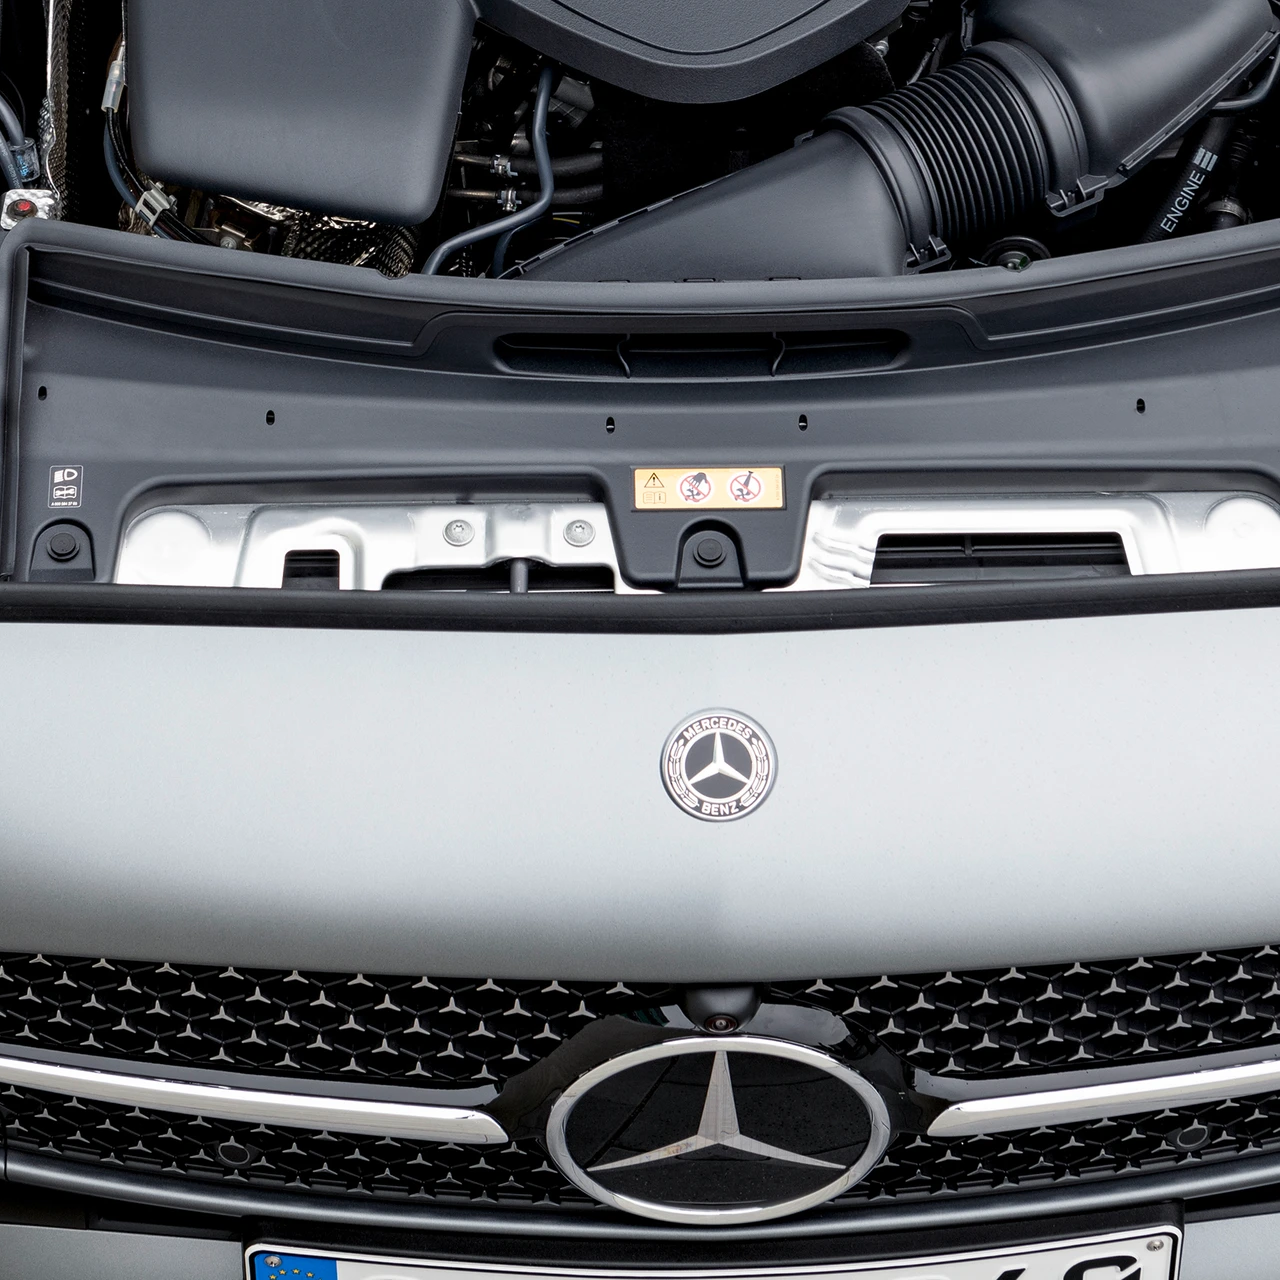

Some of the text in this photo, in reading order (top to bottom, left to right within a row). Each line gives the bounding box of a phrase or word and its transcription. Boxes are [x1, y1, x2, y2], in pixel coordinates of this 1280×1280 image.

[1160, 170, 1206, 233] ENGINE
[683, 717, 753, 740] MERCEDES
[701, 801, 739, 816] BENZ
